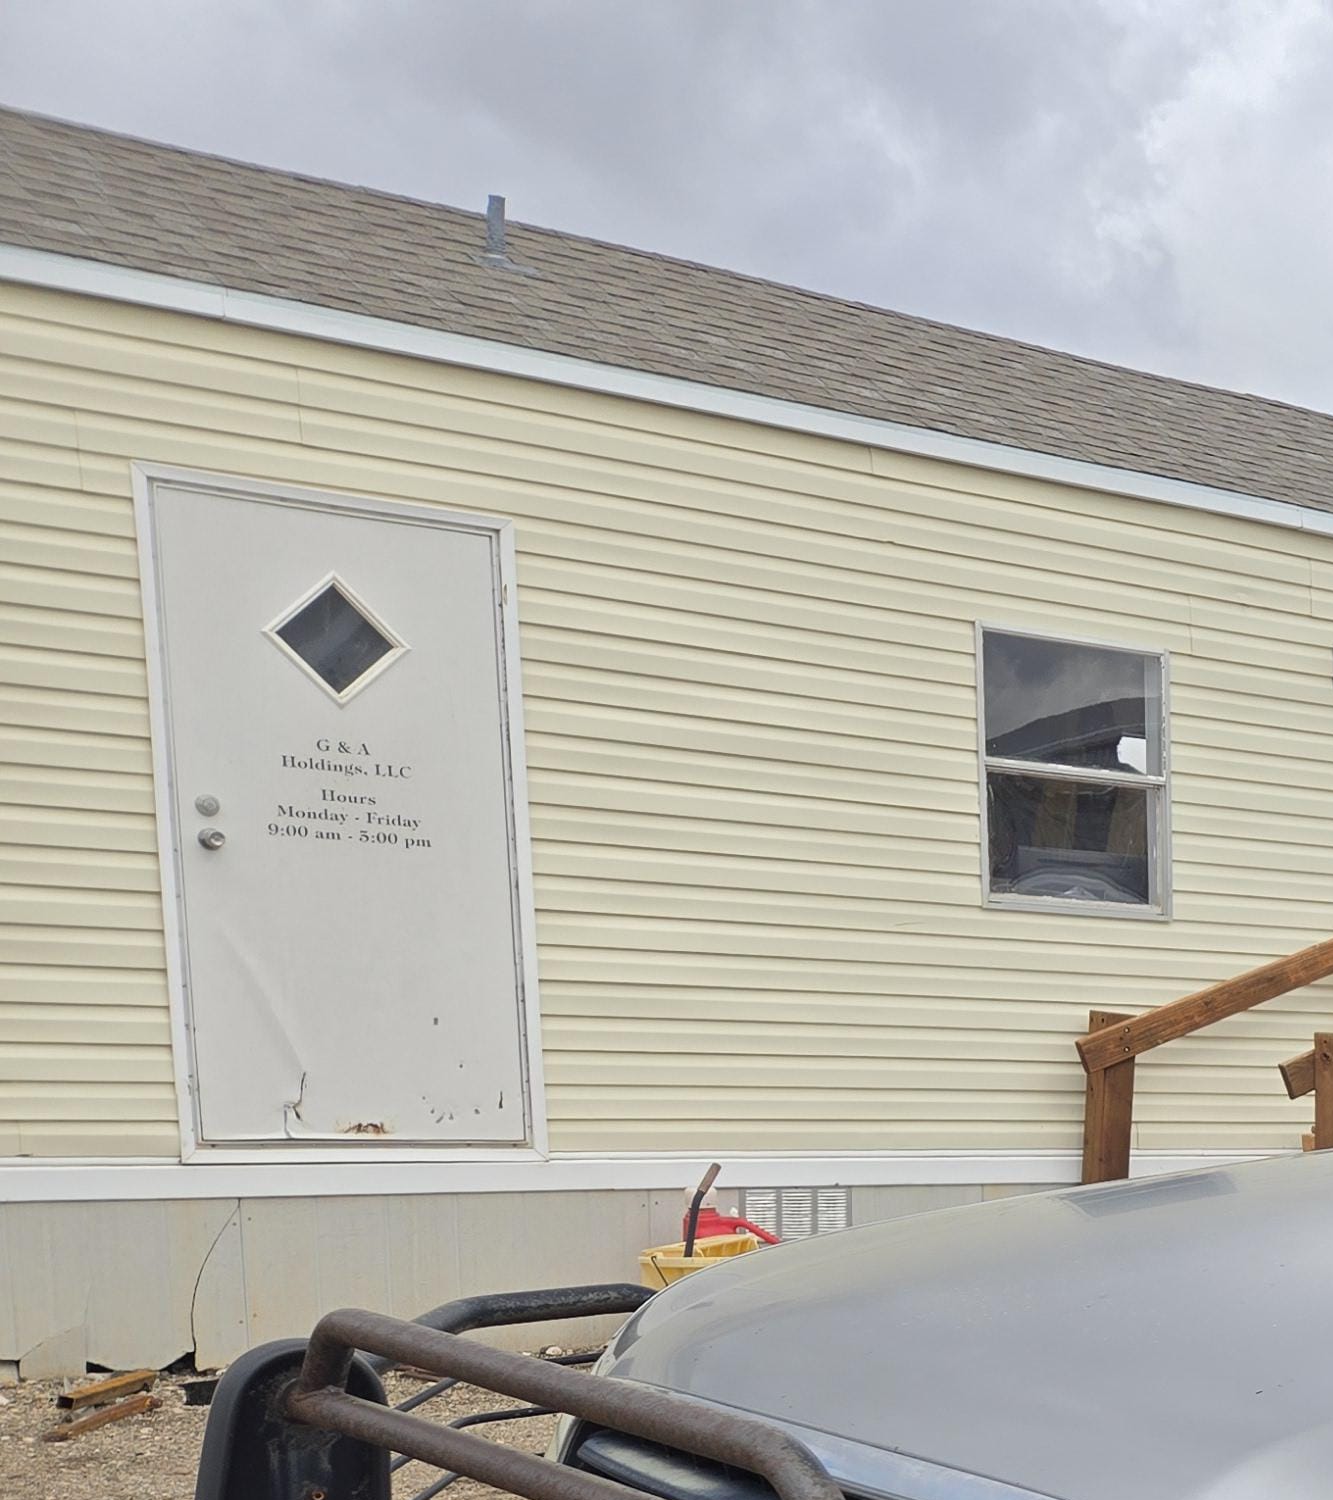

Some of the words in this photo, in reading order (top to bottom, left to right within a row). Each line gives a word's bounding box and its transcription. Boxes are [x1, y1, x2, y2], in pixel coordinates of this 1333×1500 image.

[316, 738, 330, 752] G
[337, 740, 352, 754] &
[357, 743, 371, 756] A
[375, 763, 412, 779] LLC
[321, 788, 377, 806] Hours
[276, 804, 349, 825] Monday
[366, 811, 422, 831] Friday
[267, 823, 309, 838] 9:00
[314, 829, 341, 841] am
[358, 830, 398, 845] 5:00
[404, 837, 432, 849] pm
